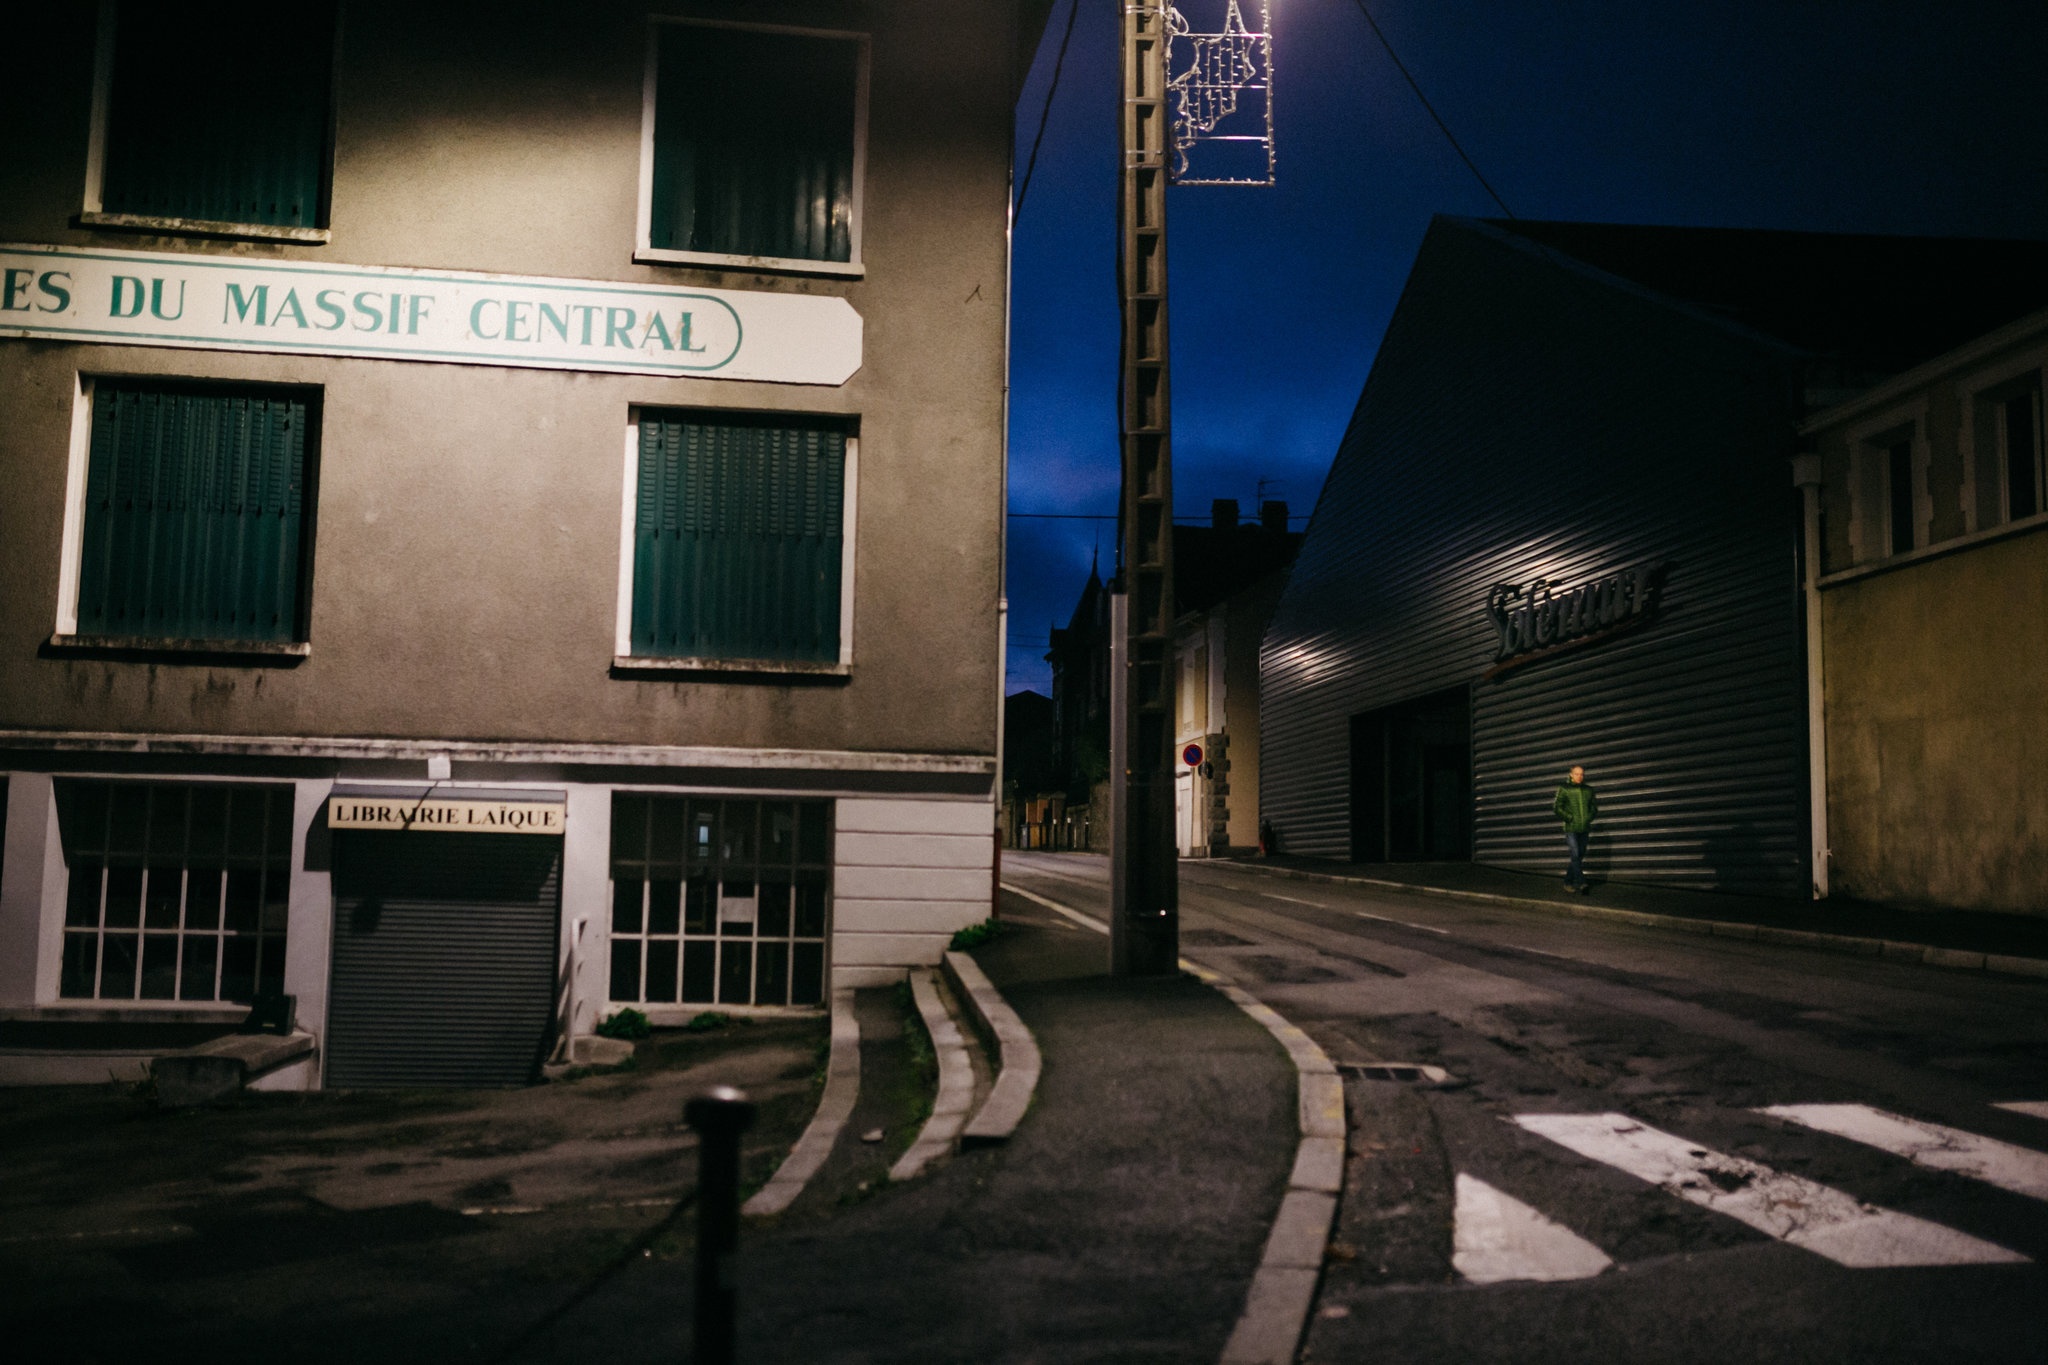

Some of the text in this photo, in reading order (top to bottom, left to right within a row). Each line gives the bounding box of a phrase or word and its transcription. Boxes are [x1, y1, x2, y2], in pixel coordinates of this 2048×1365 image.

[1, 267, 707, 354] ES DU MASSIF CENTRAL
[336, 804, 557, 827] LIBRAIRIE LAÏQUE
